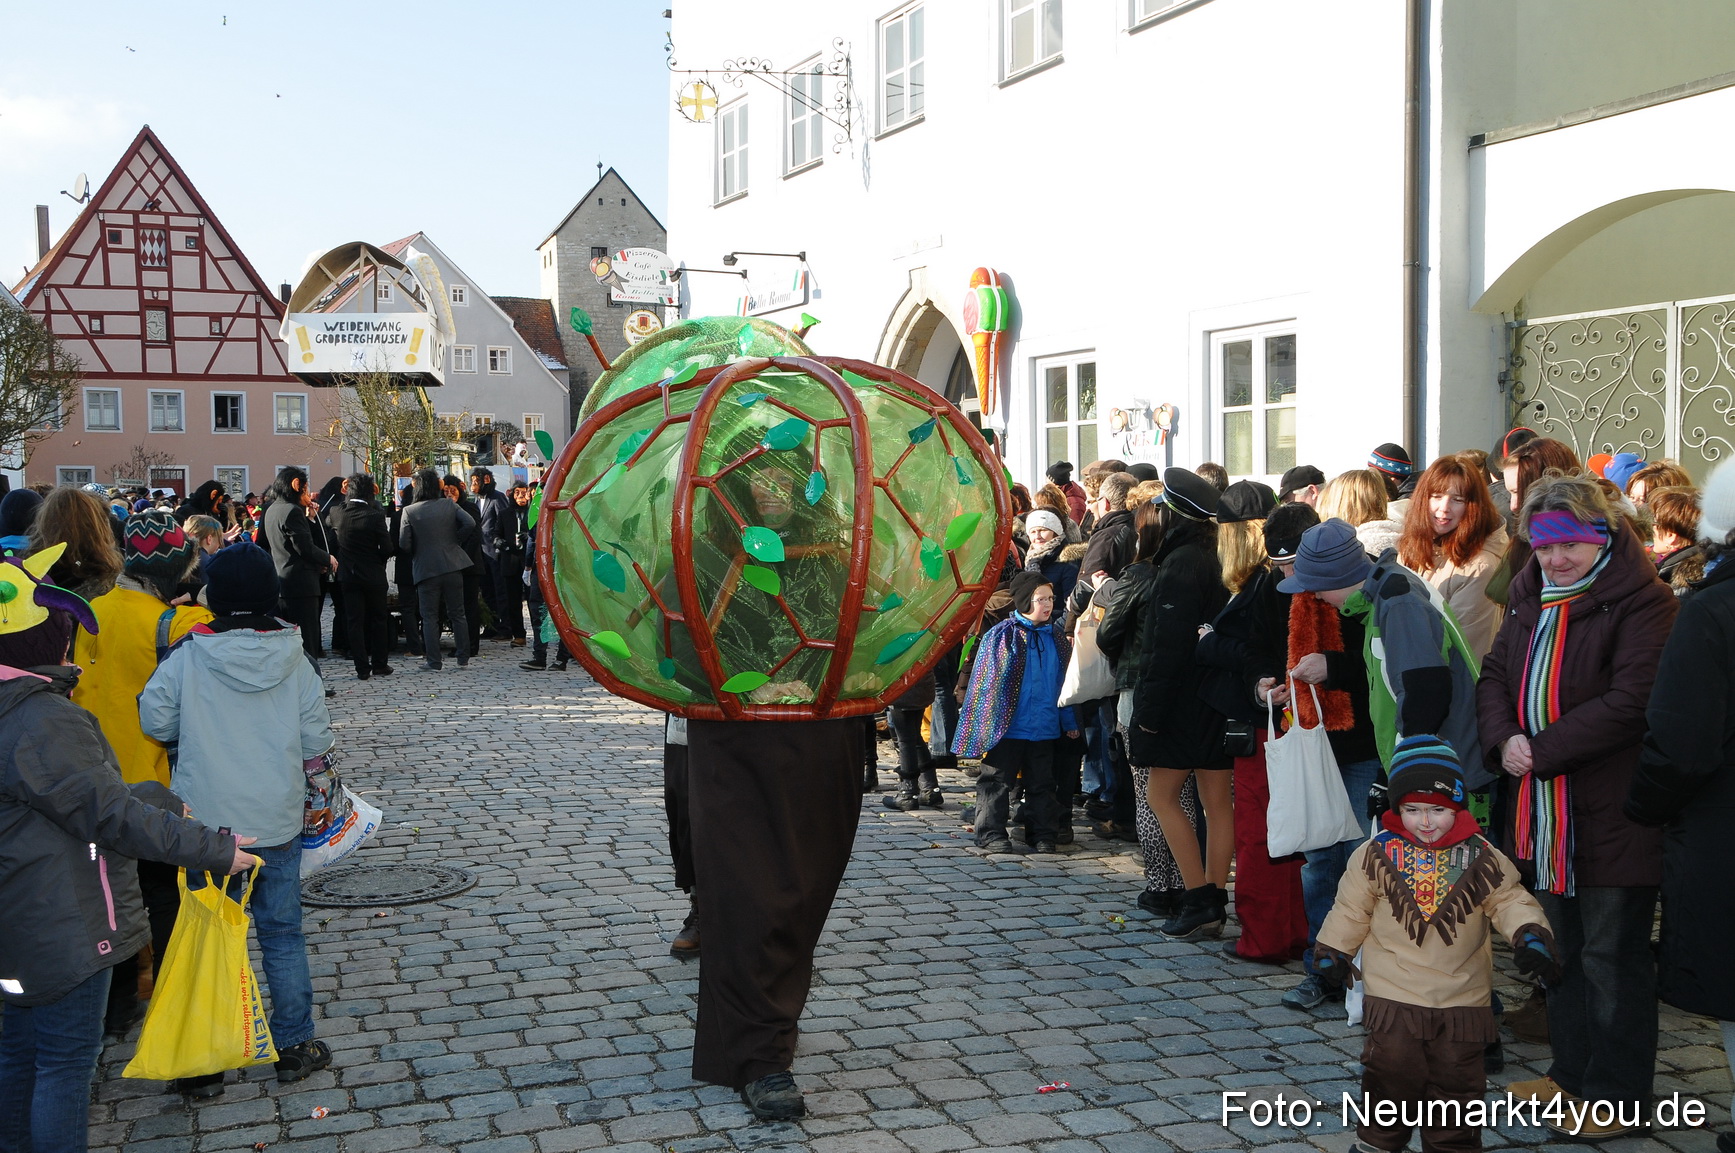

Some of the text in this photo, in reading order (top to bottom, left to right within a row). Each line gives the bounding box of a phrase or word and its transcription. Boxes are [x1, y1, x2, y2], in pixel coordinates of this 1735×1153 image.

[626, 250, 659, 260] Pizzeria
[634, 262, 652, 270] Café
[625, 271, 660, 282] Eisdiele
[748, 294, 767, 312] Bella
[323, 321, 402, 332] WEIDENWANG
[241, 987, 249, 1003] wie
[242, 1004, 252, 1058] selbstgemacht
